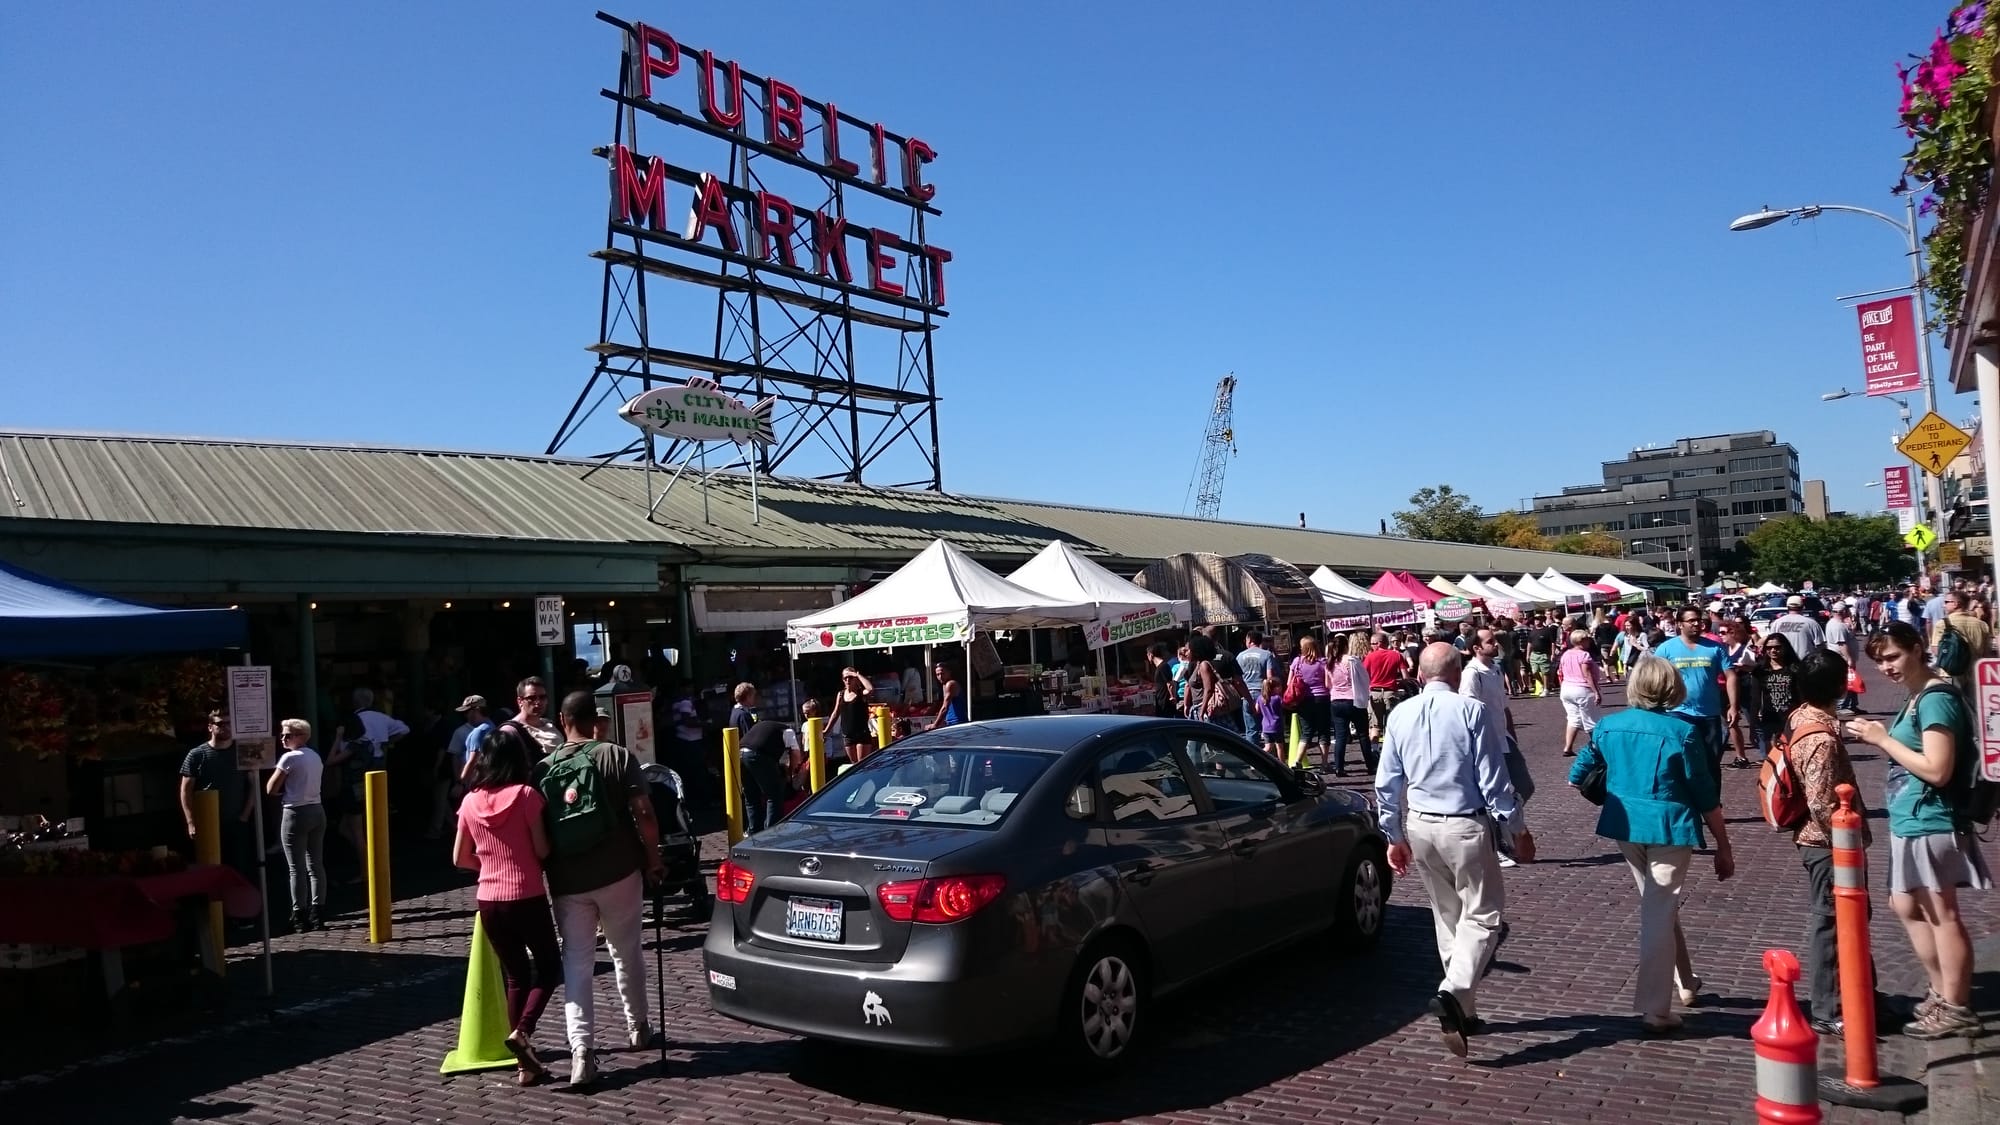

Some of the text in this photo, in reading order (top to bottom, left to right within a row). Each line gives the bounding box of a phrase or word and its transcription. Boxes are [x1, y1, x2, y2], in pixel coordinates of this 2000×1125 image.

[632, 21, 936, 201] PUBLIC
[609, 143, 952, 306] MARKET
[1862, 307, 1893, 325] PIKE UP!
[1864, 333, 1875, 342] BE
[1865, 342, 1886, 352] PART
[1867, 351, 1896, 363] OF THE
[1868, 361, 1899, 374] LEGACY
[683, 393, 728, 410] CITY
[646, 407, 761, 431] FISH MARKET
[1920, 422, 1946, 432] YIELD
[1928, 432, 1939, 440] TO
[1906, 438, 1964, 452] PEDESTRIANS
[539, 600, 560, 611] ONE
[539, 613, 560, 625] WAY
[857, 616, 929, 630] APPLE CIDER
[1121, 612, 1140, 623] APPLE
[1109, 611, 1171, 641] SLUSHIES
[834, 622, 955, 648] SLUSHIES
[790, 910, 840, 932] ARN6765
